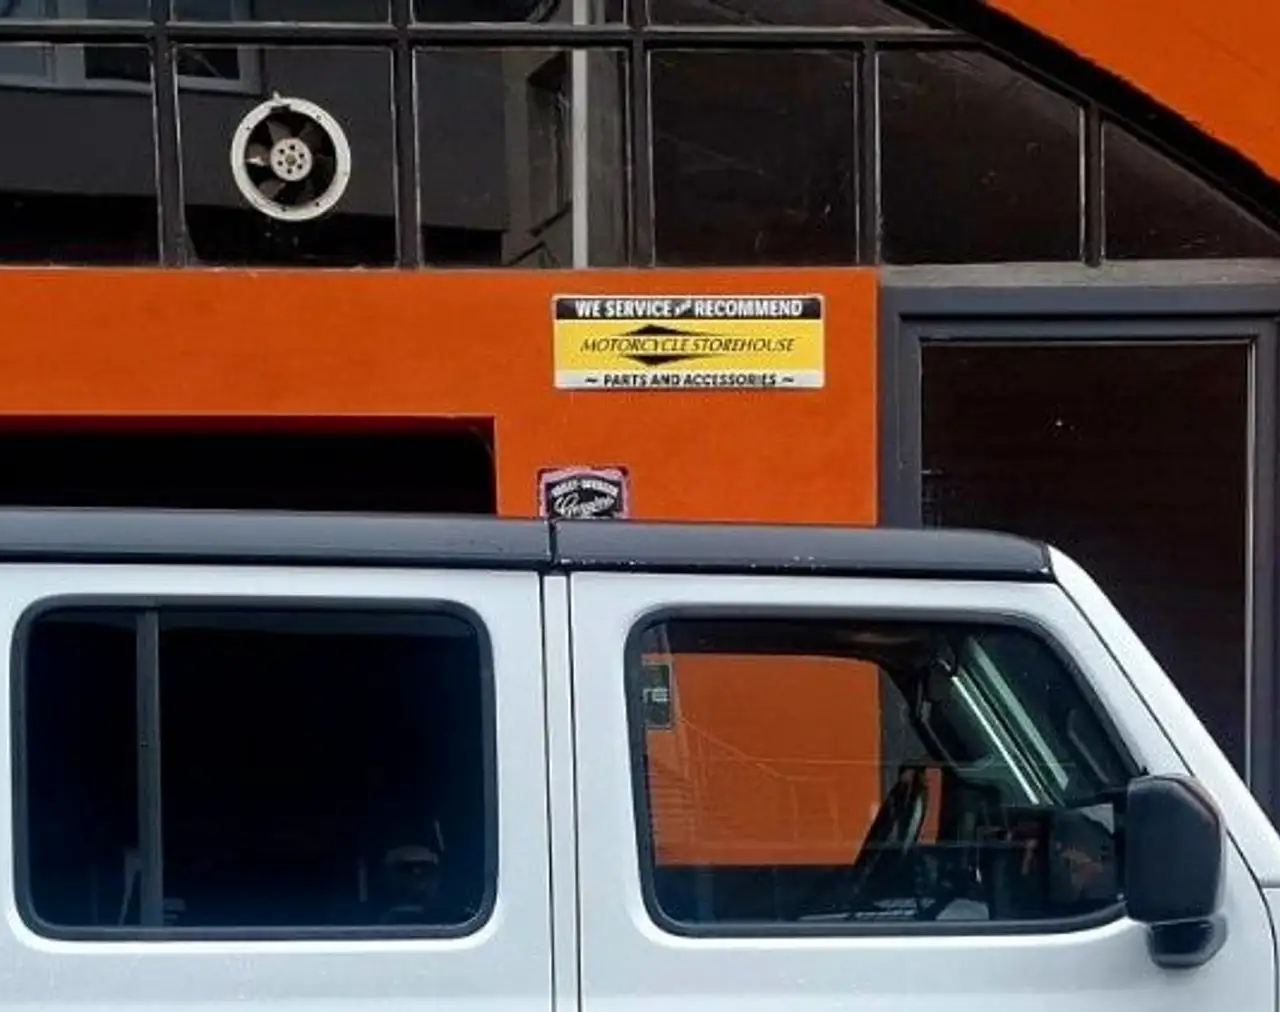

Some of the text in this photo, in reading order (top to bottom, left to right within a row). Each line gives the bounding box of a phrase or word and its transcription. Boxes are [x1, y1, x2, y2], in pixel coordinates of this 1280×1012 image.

[575, 300, 600, 317] WE
[604, 300, 670, 317] SERVICE
[694, 300, 803, 317] RECOMMEND
[580, 338, 796, 352] MOTORCYCLE STOREHOUSE
[604, 373, 777, 386] PARTS AND ACCESSORIES
